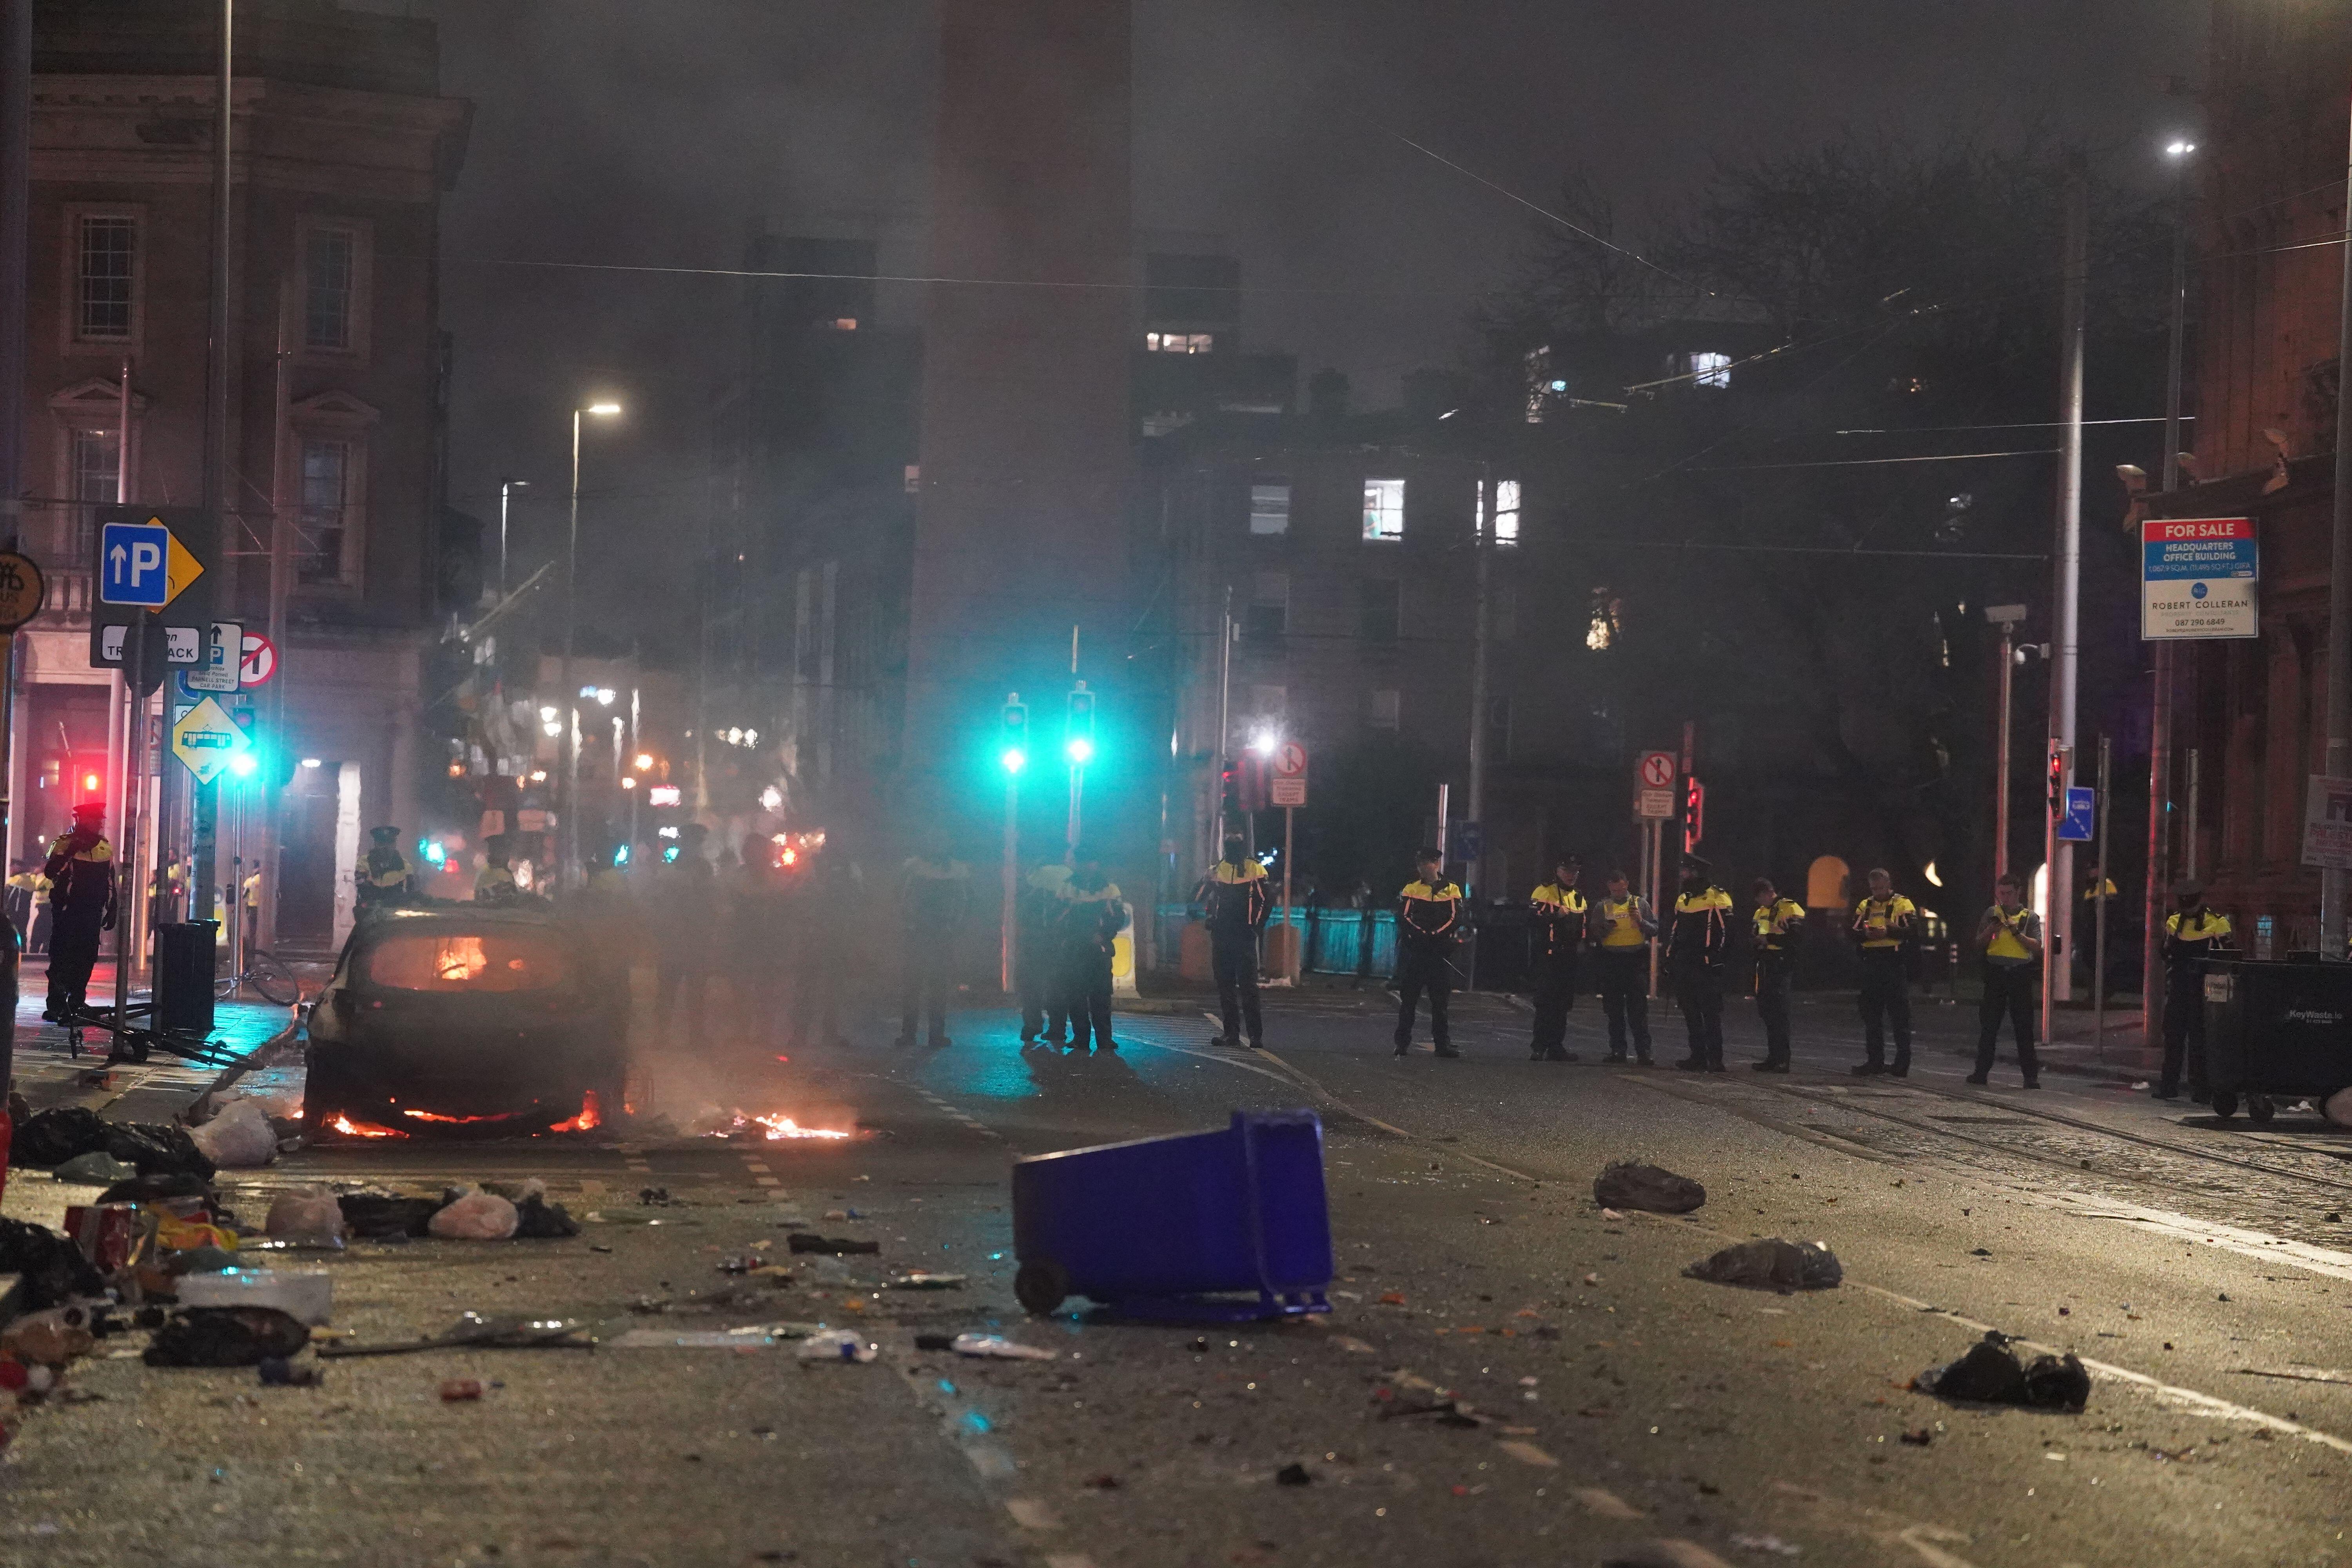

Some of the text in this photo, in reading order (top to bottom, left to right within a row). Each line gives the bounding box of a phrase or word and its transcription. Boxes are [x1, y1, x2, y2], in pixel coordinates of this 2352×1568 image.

[2165, 523, 2234, 537] FOR SALE
[2166, 542, 2234, 552] HEADQUARTERS
[2163, 552, 2236, 562] OFFICE BUILDING
[131, 542, 160, 587] P
[2195, 600, 2248, 608] COLLERAN
[107, 646, 193, 658] TR ACK
[2289, 1010, 2343, 1020] KeyWaste.ie
